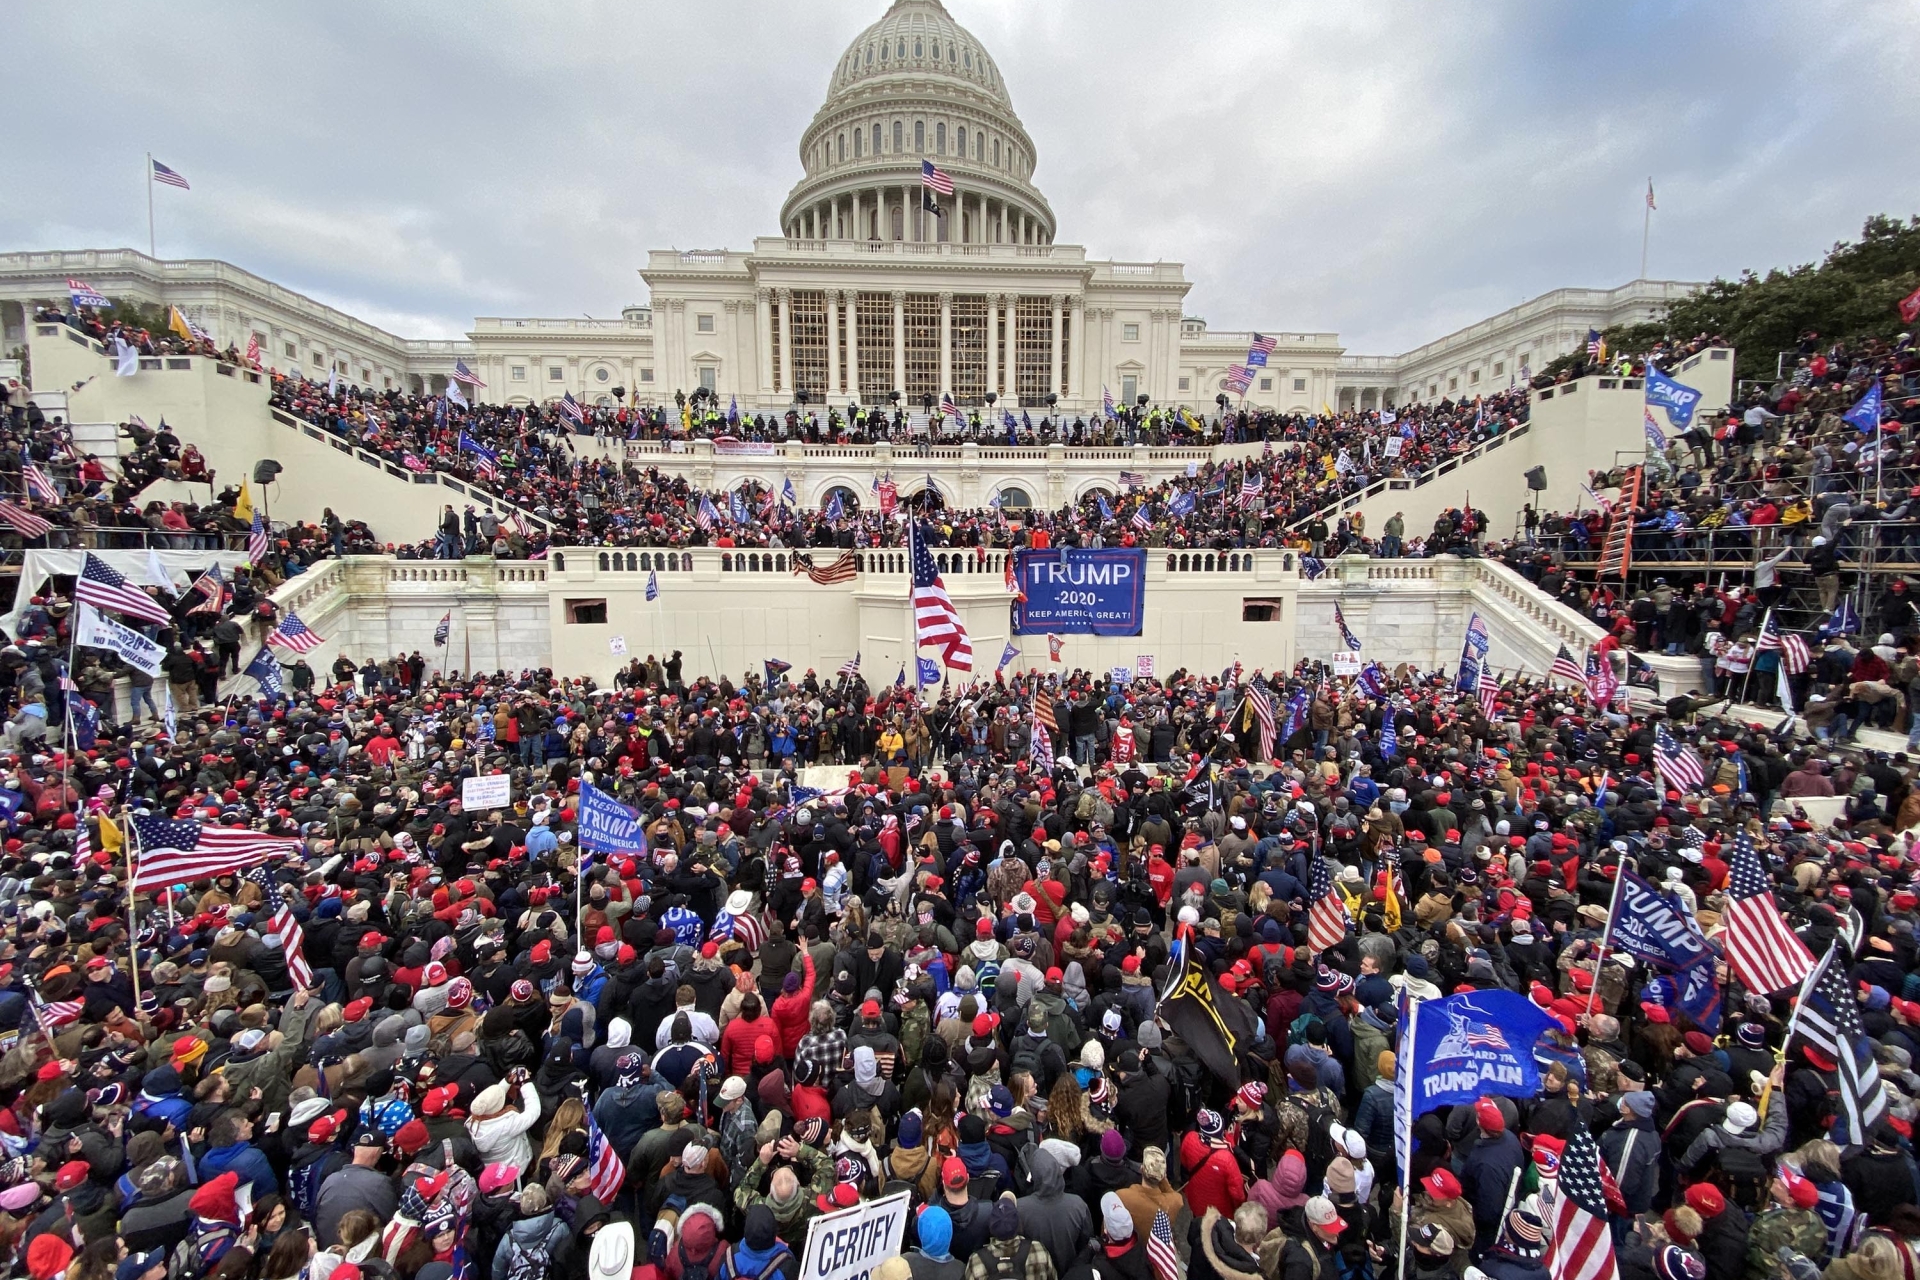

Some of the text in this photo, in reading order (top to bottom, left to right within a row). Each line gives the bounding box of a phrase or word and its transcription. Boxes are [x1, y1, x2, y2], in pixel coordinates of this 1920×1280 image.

[1029, 562, 1131, 585] TRUMP
[1029, 610, 1131, 619] KEEP AMERICA GREAT!
[93, 636, 105, 645] NO
[120, 648, 155, 670] BULLSHIT
[117, 632, 140, 651] 2020
[265, 672, 281, 692] 2020
[582, 806, 638, 838] TRUMP
[1622, 876, 1704, 953] RUMP
[1642, 942, 1670, 959] GREA
[1423, 1062, 1523, 1098] TRUMP AIN
[818, 1211, 897, 1277] CERTIFY
